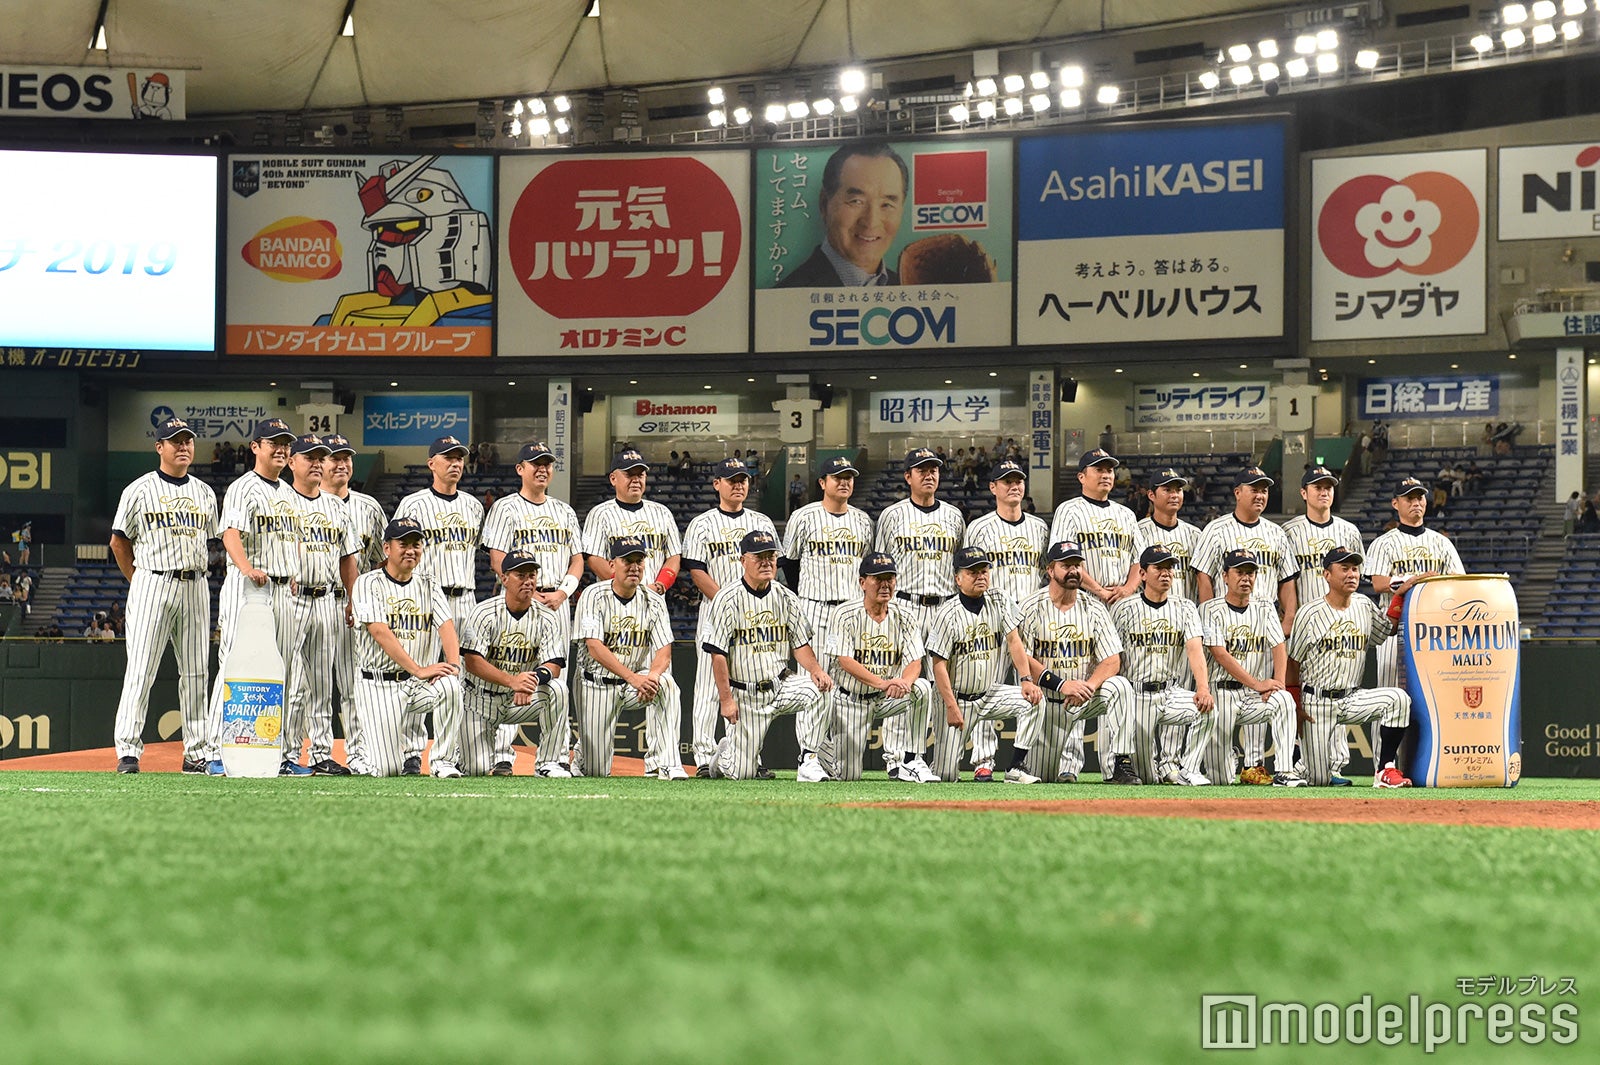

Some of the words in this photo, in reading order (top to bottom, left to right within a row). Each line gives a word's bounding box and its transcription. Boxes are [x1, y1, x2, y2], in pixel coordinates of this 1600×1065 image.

[0, 72, 113, 112] EOS
[262, 159, 299, 168] MOBILE
[301, 159, 324, 168] SUIT
[327, 159, 366, 168] GUNDAM
[262, 170, 284, 178] 40th
[286, 170, 353, 178] ANNIVERSARY
[574, 186, 671, 231] 元気
[917, 205, 983, 224] SECOM
[259, 237, 331, 252] BANDAI
[45, 239, 178, 276] 2019
[259, 253, 331, 268] NAMCO
[1038, 284, 1262, 322] ヘーベルハウス
[1335, 281, 1460, 321] シマダヤ
[809, 306, 956, 346] SECOM
[243, 331, 388, 353] バンダイナムコ
[394, 330, 476, 353] グループ
[560, 326, 687, 349] オロナミンC
[0, 348, 26, 366] 機
[1138, 386, 1265, 410] ニッテイライフ
[1290, 398, 1299, 416] 1
[1365, 380, 1491, 415] 日総工産
[186, 406, 266, 417] サッポロ生ビール
[636, 399, 717, 416] Bishamon
[879, 395, 990, 423] 昭和大学
[309, 415, 331, 433] 34
[366, 411, 467, 430] 文化シャッター
[790, 411, 802, 429] 3
[1560, 385, 1578, 455] 三機工業
[0, 452, 51, 489] BI
[387, 597, 420, 613] The
[1441, 598, 1497, 622] The
[1049, 622, 1084, 640] The
[1414, 620, 1517, 651] PREMIUM
[1033, 637, 1096, 659] PREMIUM
[226, 704, 280, 717] SPARKLING
[1545, 723, 1591, 739] Good
[1443, 745, 1501, 754] SUNTORY
[1545, 741, 1591, 757] Good
